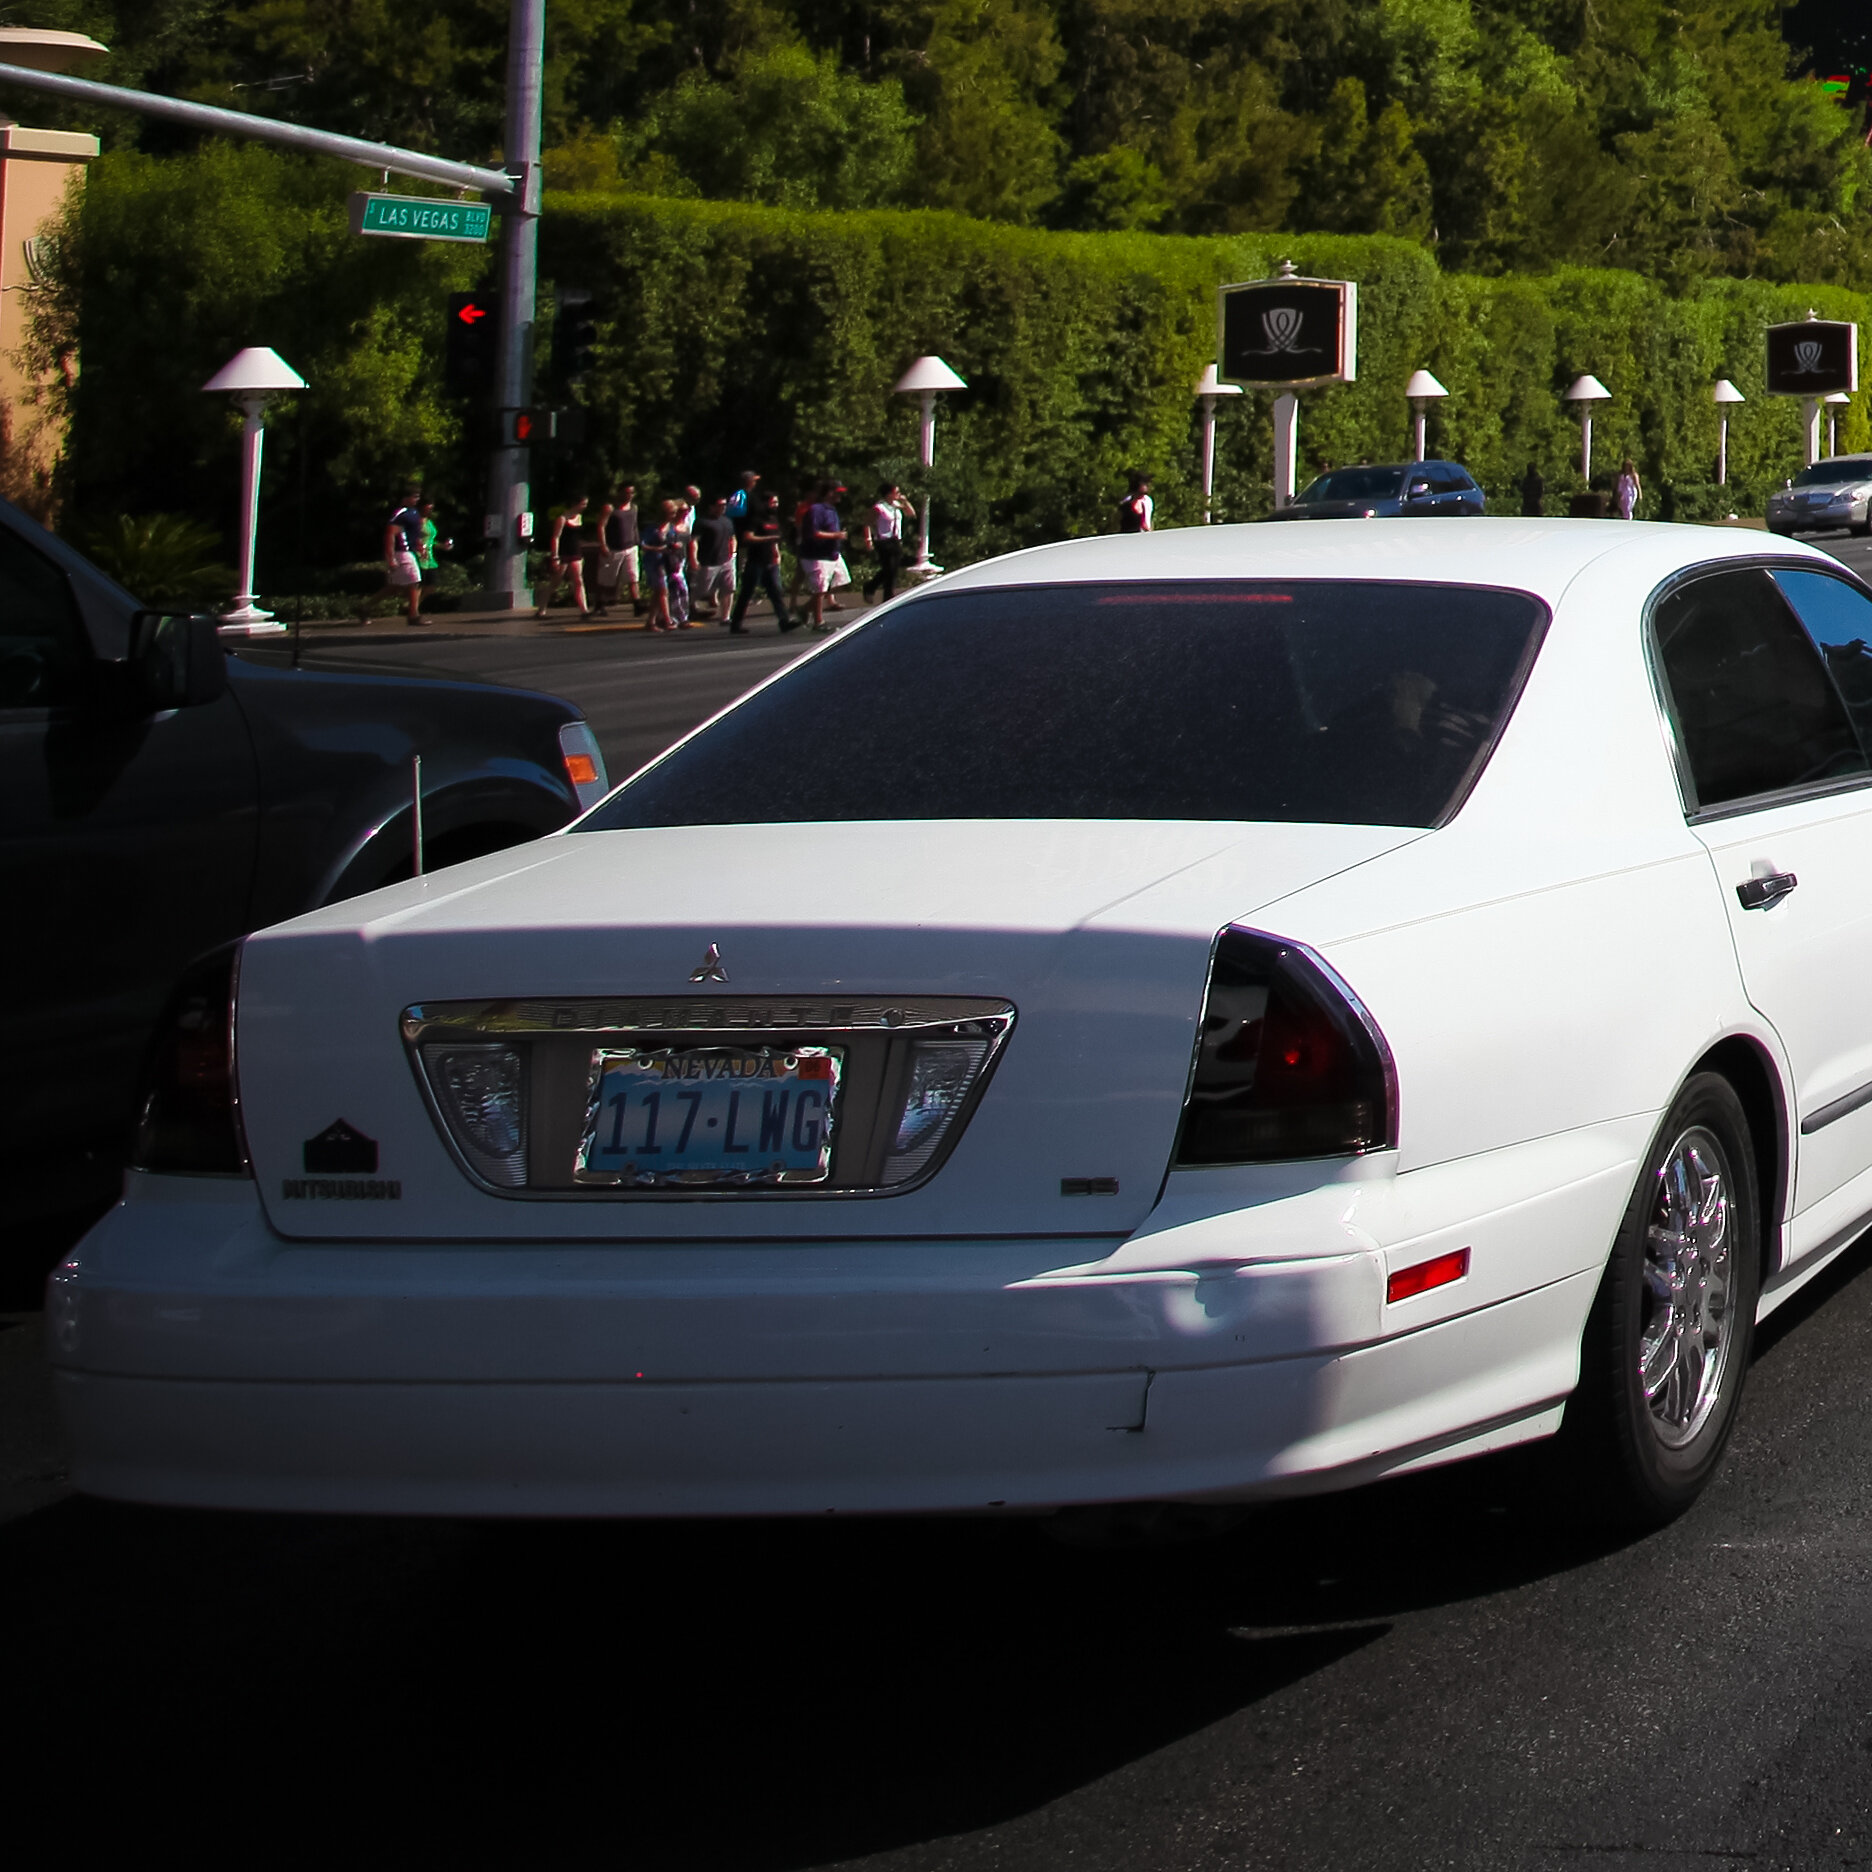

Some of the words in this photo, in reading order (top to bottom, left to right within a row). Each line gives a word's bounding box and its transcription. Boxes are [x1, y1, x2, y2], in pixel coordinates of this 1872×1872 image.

[379, 207, 408, 226] LAS
[413, 209, 459, 230] VEGAS
[663, 1058, 775, 1079] NEVADA
[283, 1179, 402, 1200] MITSUBISHI
